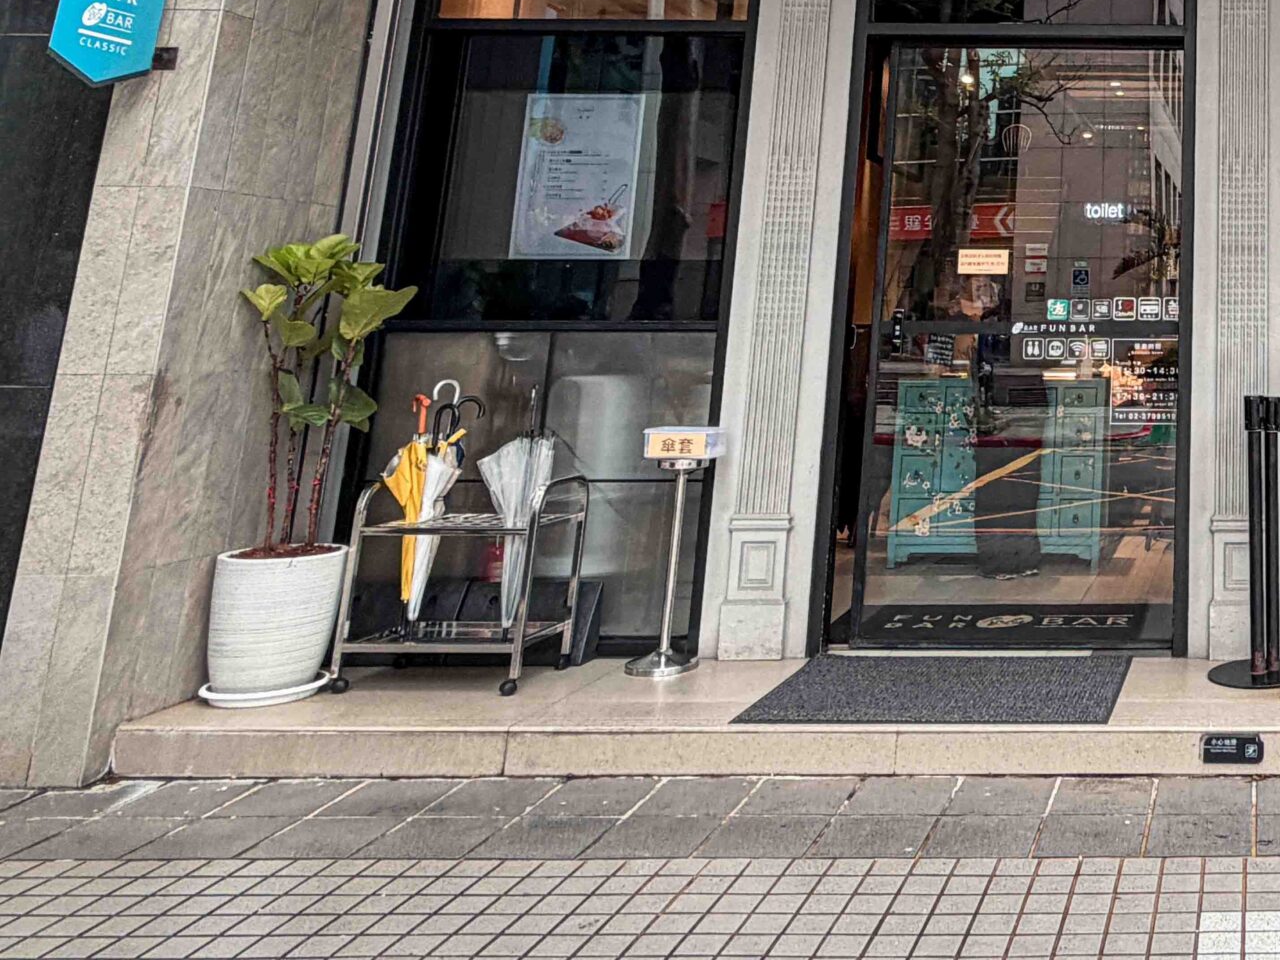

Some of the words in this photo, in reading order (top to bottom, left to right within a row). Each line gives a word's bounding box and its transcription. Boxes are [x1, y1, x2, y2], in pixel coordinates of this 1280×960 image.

[106, 12, 133, 29] BAR
[79, 36, 128, 56] CLASSIC
[1085, 202, 1124, 219] toilet
[1069, 324, 1096, 333] BAR
[660, 437, 694, 454] 傘套
[1041, 616, 1130, 626] BAR
